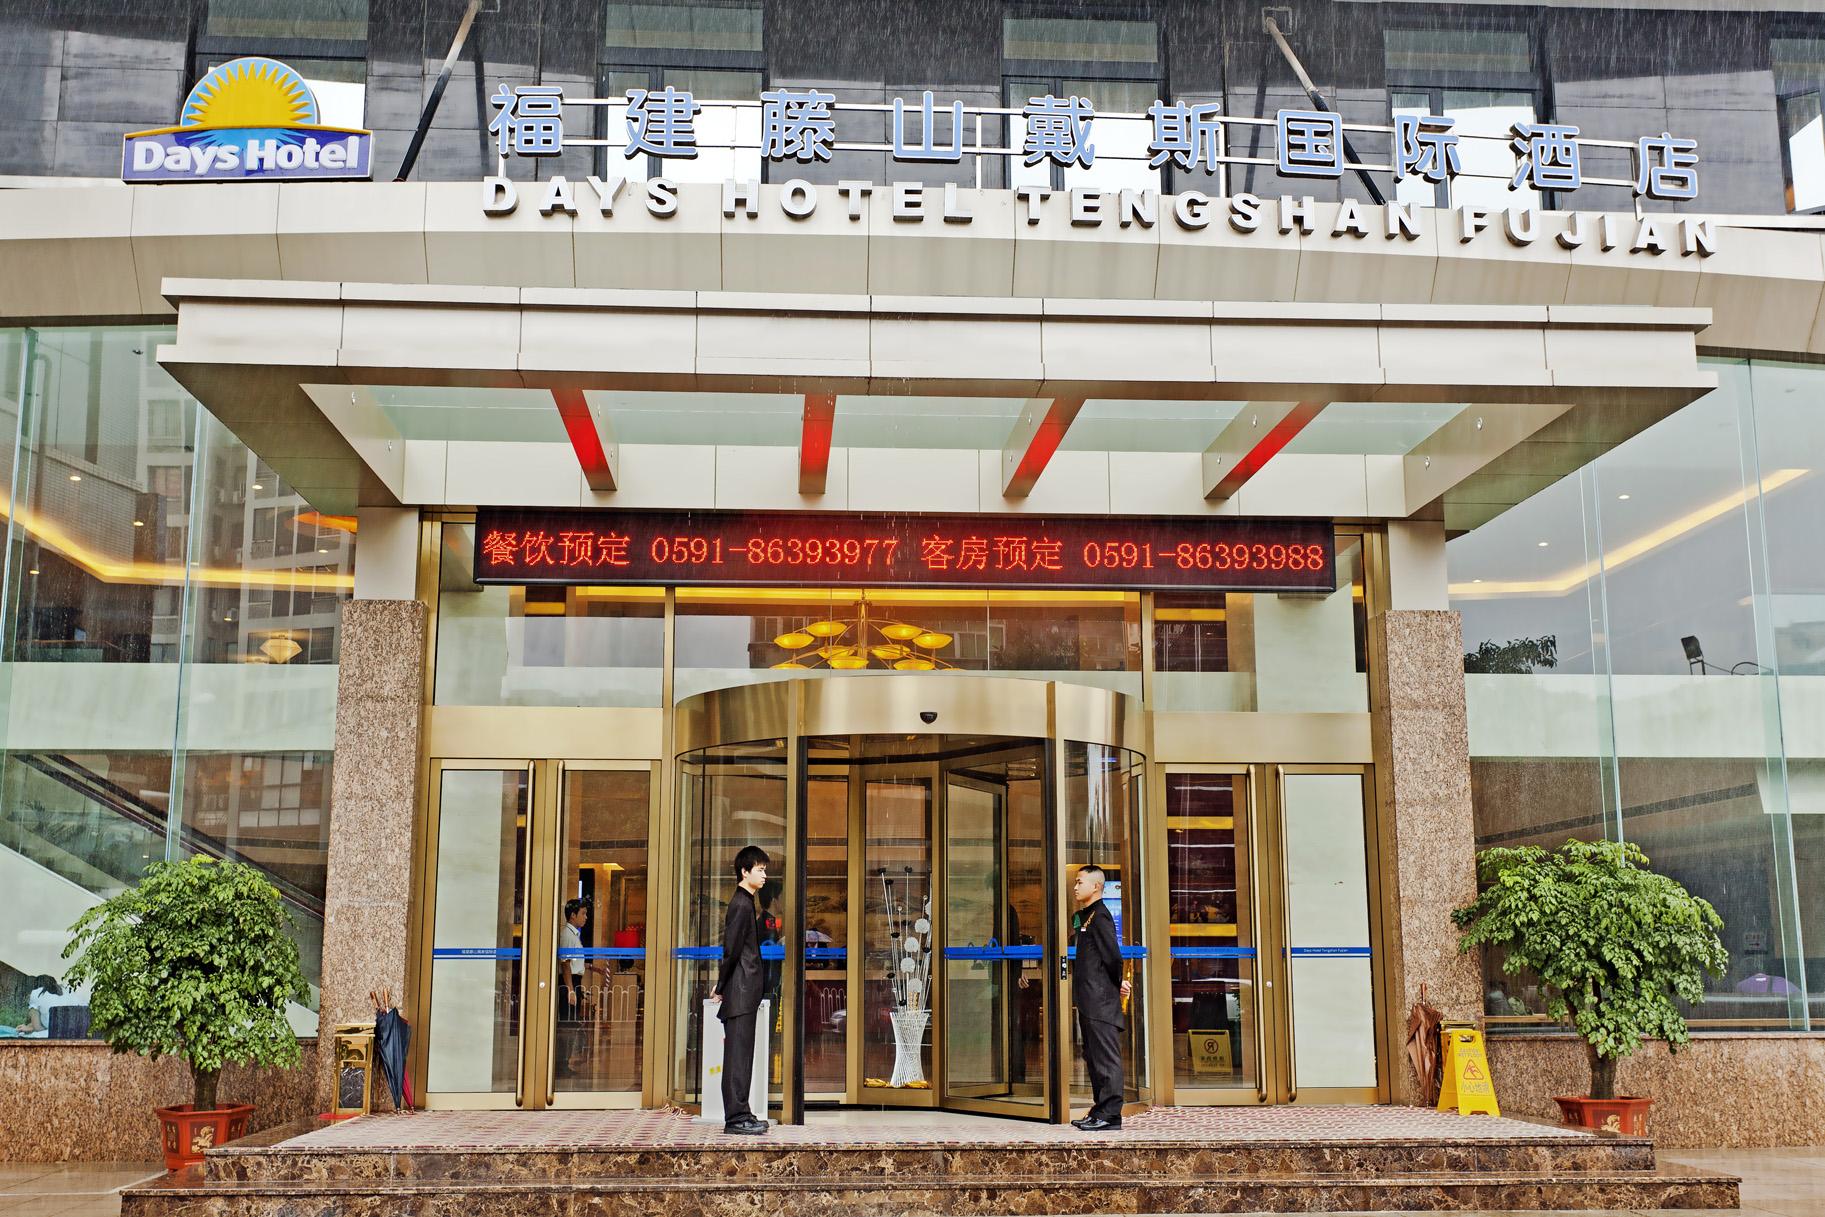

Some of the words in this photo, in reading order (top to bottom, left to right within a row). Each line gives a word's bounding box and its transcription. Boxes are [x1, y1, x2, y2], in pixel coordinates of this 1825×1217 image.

[133, 140, 240, 176] Days
[245, 136, 361, 171] Hotel
[488, 83, 1700, 200] 福建藤山戴斯国际酒店
[483, 175, 678, 218] DAYS
[722, 178, 974, 223] HOTEL
[1016, 184, 1421, 241] TENGSHAN
[1458, 203, 1716, 257] FUJIAN
[483, 531, 631, 567] 餐饮预定
[650, 536, 900, 567] 0591-86393977
[920, 535, 1063, 571] 客房预定
[1082, 541, 1325, 571] 0591-86393988
